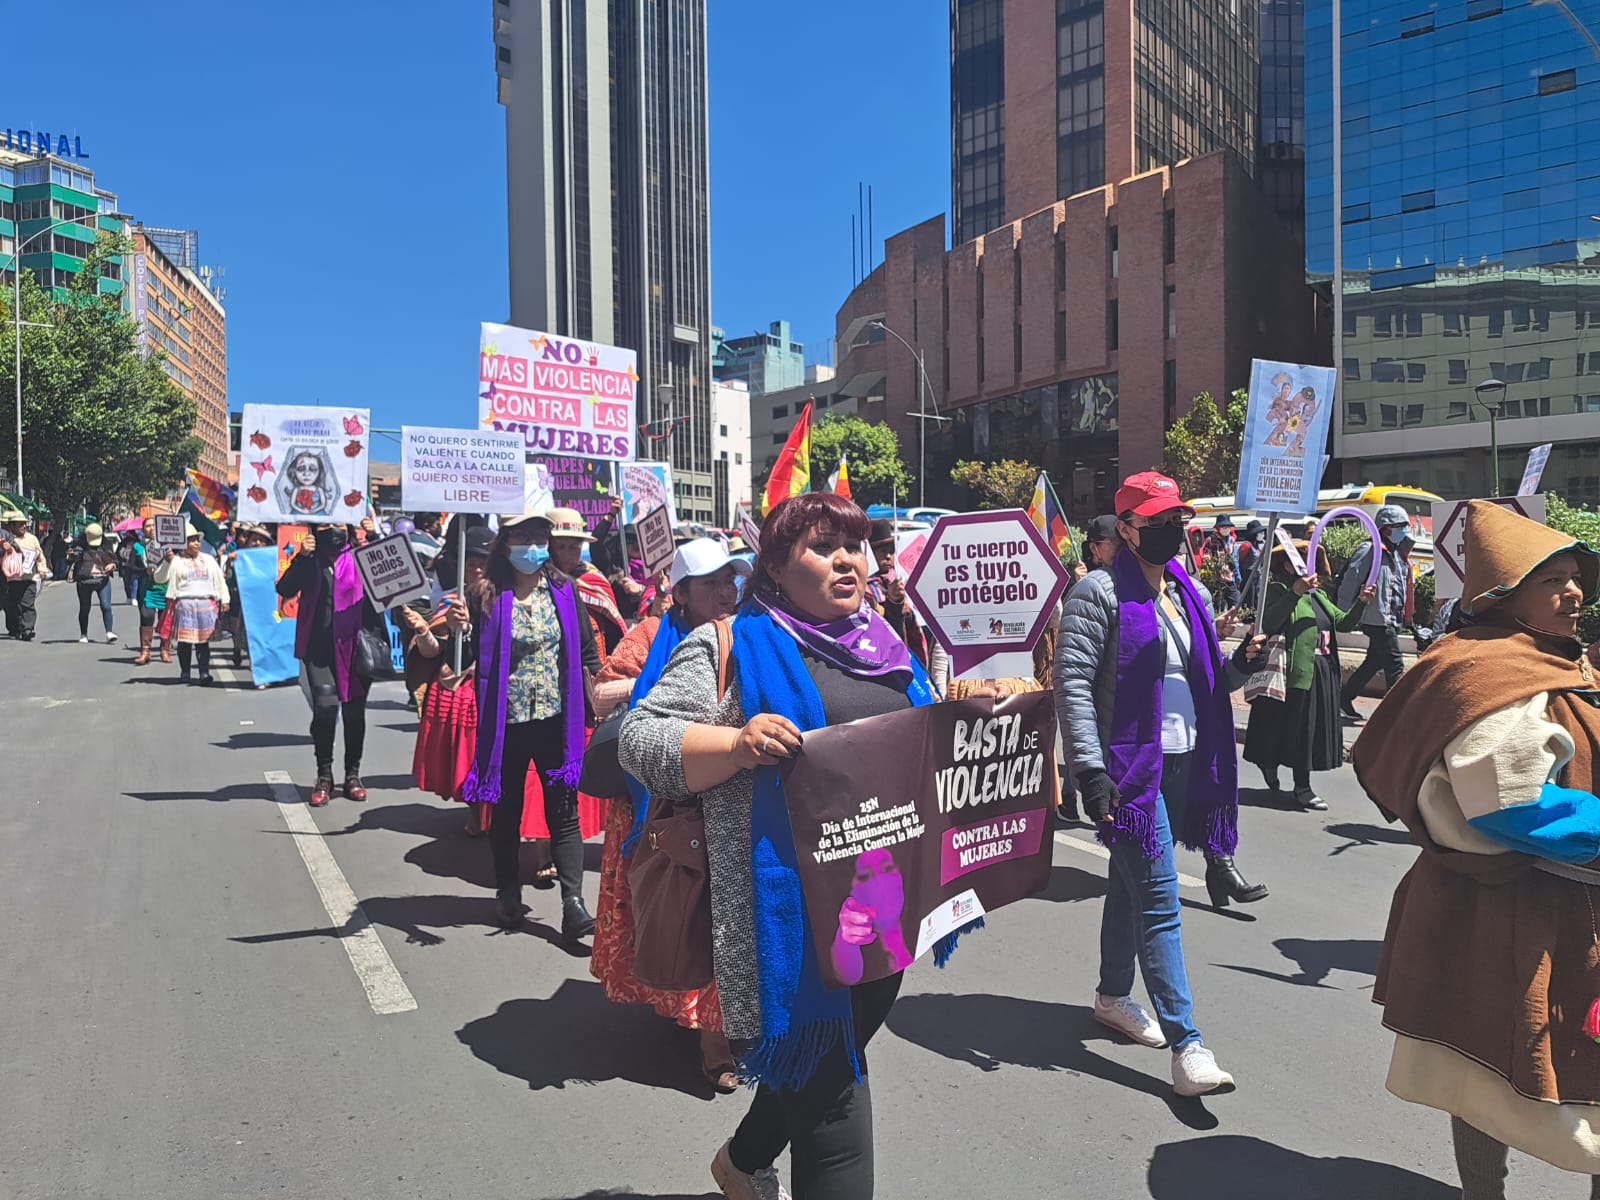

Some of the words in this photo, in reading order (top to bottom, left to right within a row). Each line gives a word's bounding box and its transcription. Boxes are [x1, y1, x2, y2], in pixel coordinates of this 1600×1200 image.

[0, 128, 89, 158] IONAL
[541, 338, 582, 364] NO
[535, 366, 632, 396] VIOLENCIA
[493, 393, 576, 422] CONTRA
[594, 406, 627, 428] LAS
[410, 434, 426, 444] NO
[428, 435, 468, 446] QUIERO
[470, 438, 520, 449] SENTIRME
[415, 447, 467, 458] VALIENTE
[470, 450, 515, 460] CUANDO
[414, 459, 451, 469] SALGA
[454, 462, 461, 470] A
[464, 462, 478, 471] LA
[480, 463, 517, 474] CALLE,
[412, 472, 458, 483] QUIERO
[461, 474, 519, 486] SENTIRME
[554, 473, 593, 490] UELAN
[1263, 475, 1301, 491] VIOLENCIA
[444, 489, 490, 502] LIBRE
[646, 526, 665, 545] calles
[384, 544, 397, 557] te
[942, 543, 961, 560] Tu
[966, 540, 1028, 559] cuerpo
[370, 556, 404, 576] calles
[945, 564, 969, 582] es
[976, 561, 1028, 582] tuyo,
[938, 581, 1038, 609] protégelo
[953, 712, 1021, 762] BASTA
[1023, 731, 1039, 750] DE
[935, 752, 1044, 814] VIOLENCIA
[859, 796, 879, 813] 25N
[842, 817, 855, 831] de
[855, 800, 916, 828] Internacional
[818, 837, 832, 849] de
[832, 834, 844, 847] la
[844, 819, 902, 844] Eliminación
[901, 815, 912, 828] de
[912, 812, 920, 825] la
[952, 822, 1000, 850] CONTRA
[1002, 817, 1027, 840] LAS
[812, 843, 864, 864] Violencia
[863, 834, 897, 852] Contra
[896, 830, 906, 843] la
[905, 823, 926, 840] Mujer
[959, 838, 1013, 867] MUJERES
